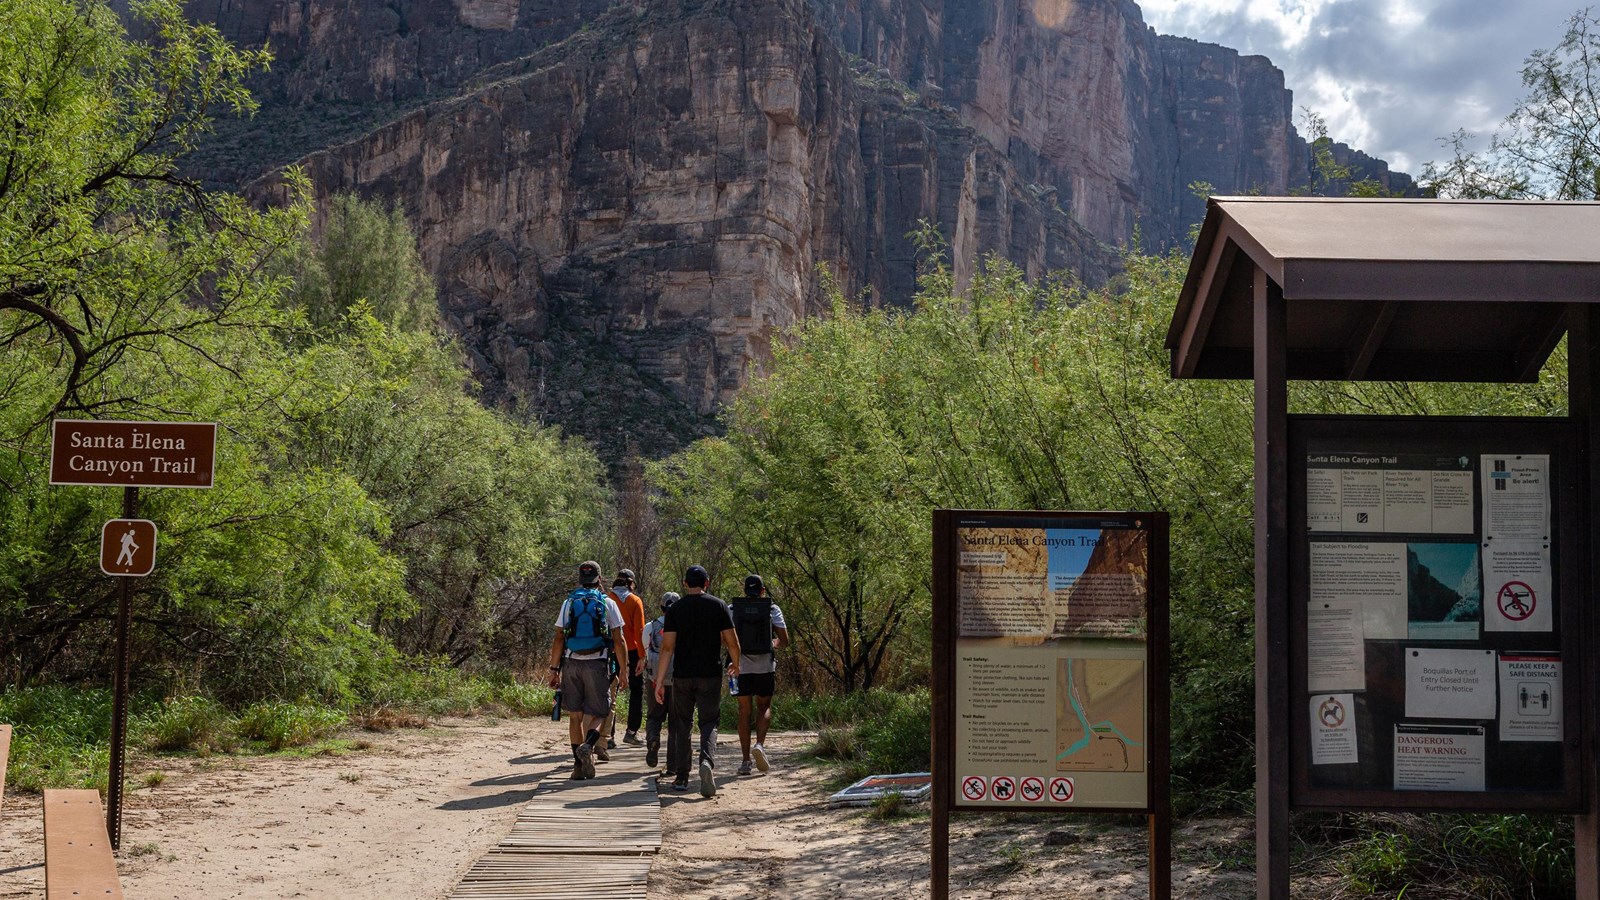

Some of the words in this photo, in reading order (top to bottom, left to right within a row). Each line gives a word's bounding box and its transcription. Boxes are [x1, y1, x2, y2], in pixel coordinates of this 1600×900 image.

[70, 432, 125, 448] Santa
[130, 433, 185, 450] Elena
[69, 455, 144, 476] Canyon
[150, 456, 196, 474] Trail
[1352, 456, 1380, 465] Canyon
[964, 536, 994, 546] Santa
[999, 536, 1028, 546] Elena
[1032, 536, 1076, 549] Canyon
[1397, 736, 1454, 744] DANGEROUS
[1424, 747, 1466, 755] WARNING
